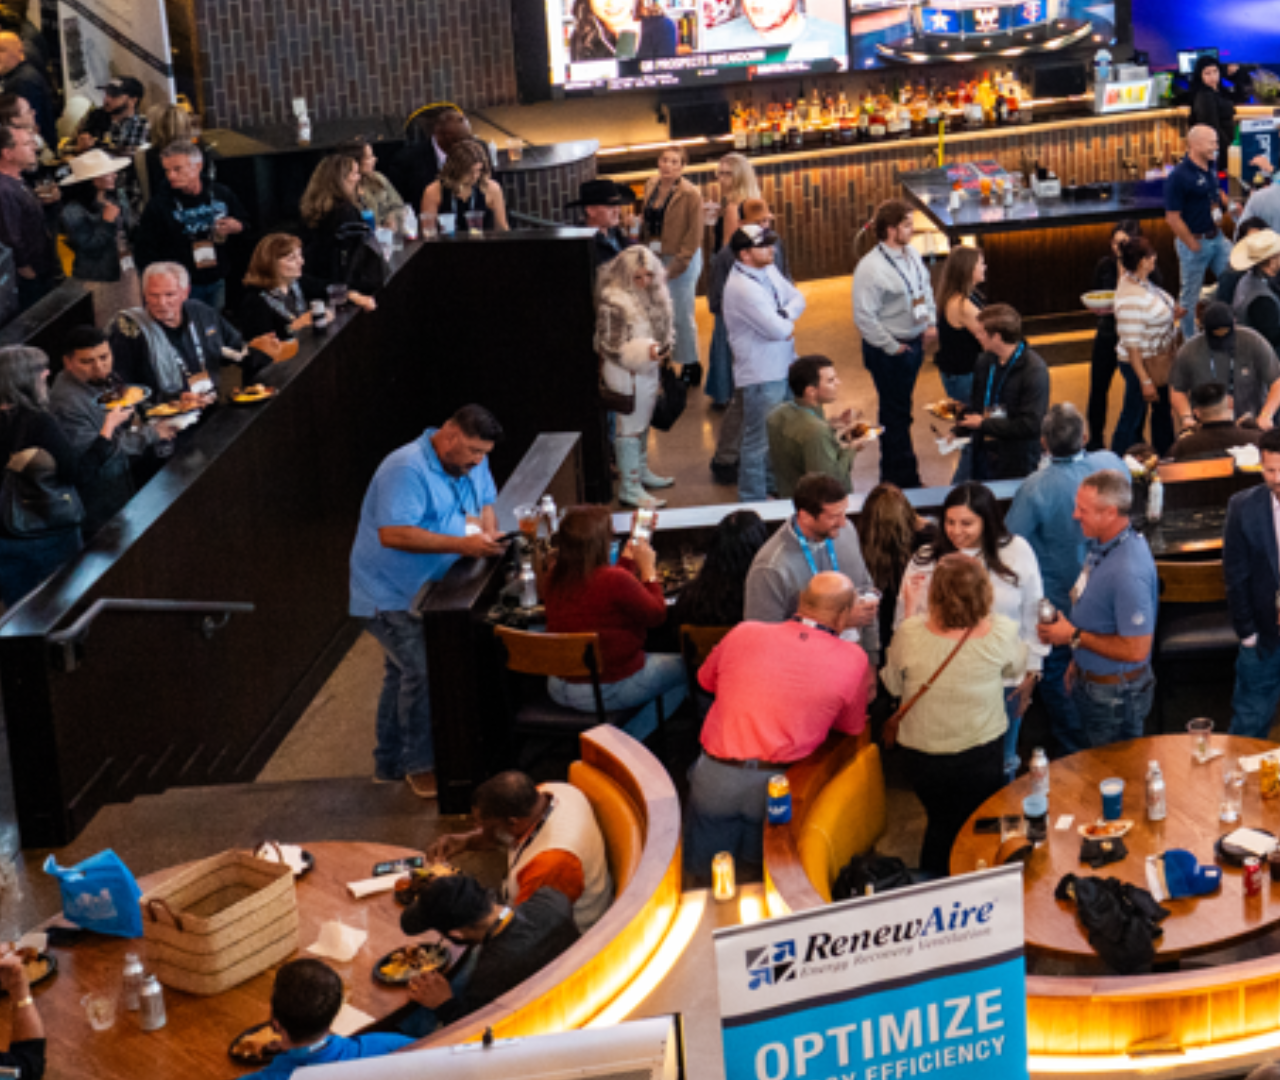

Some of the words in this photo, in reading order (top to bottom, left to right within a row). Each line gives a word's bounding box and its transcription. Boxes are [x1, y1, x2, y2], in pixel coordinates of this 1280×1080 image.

[803, 900, 995, 963] RenewAire
[754, 989, 1005, 1080] OPTIMIZE
[863, 1035, 1006, 1080] EFFICIENCY
